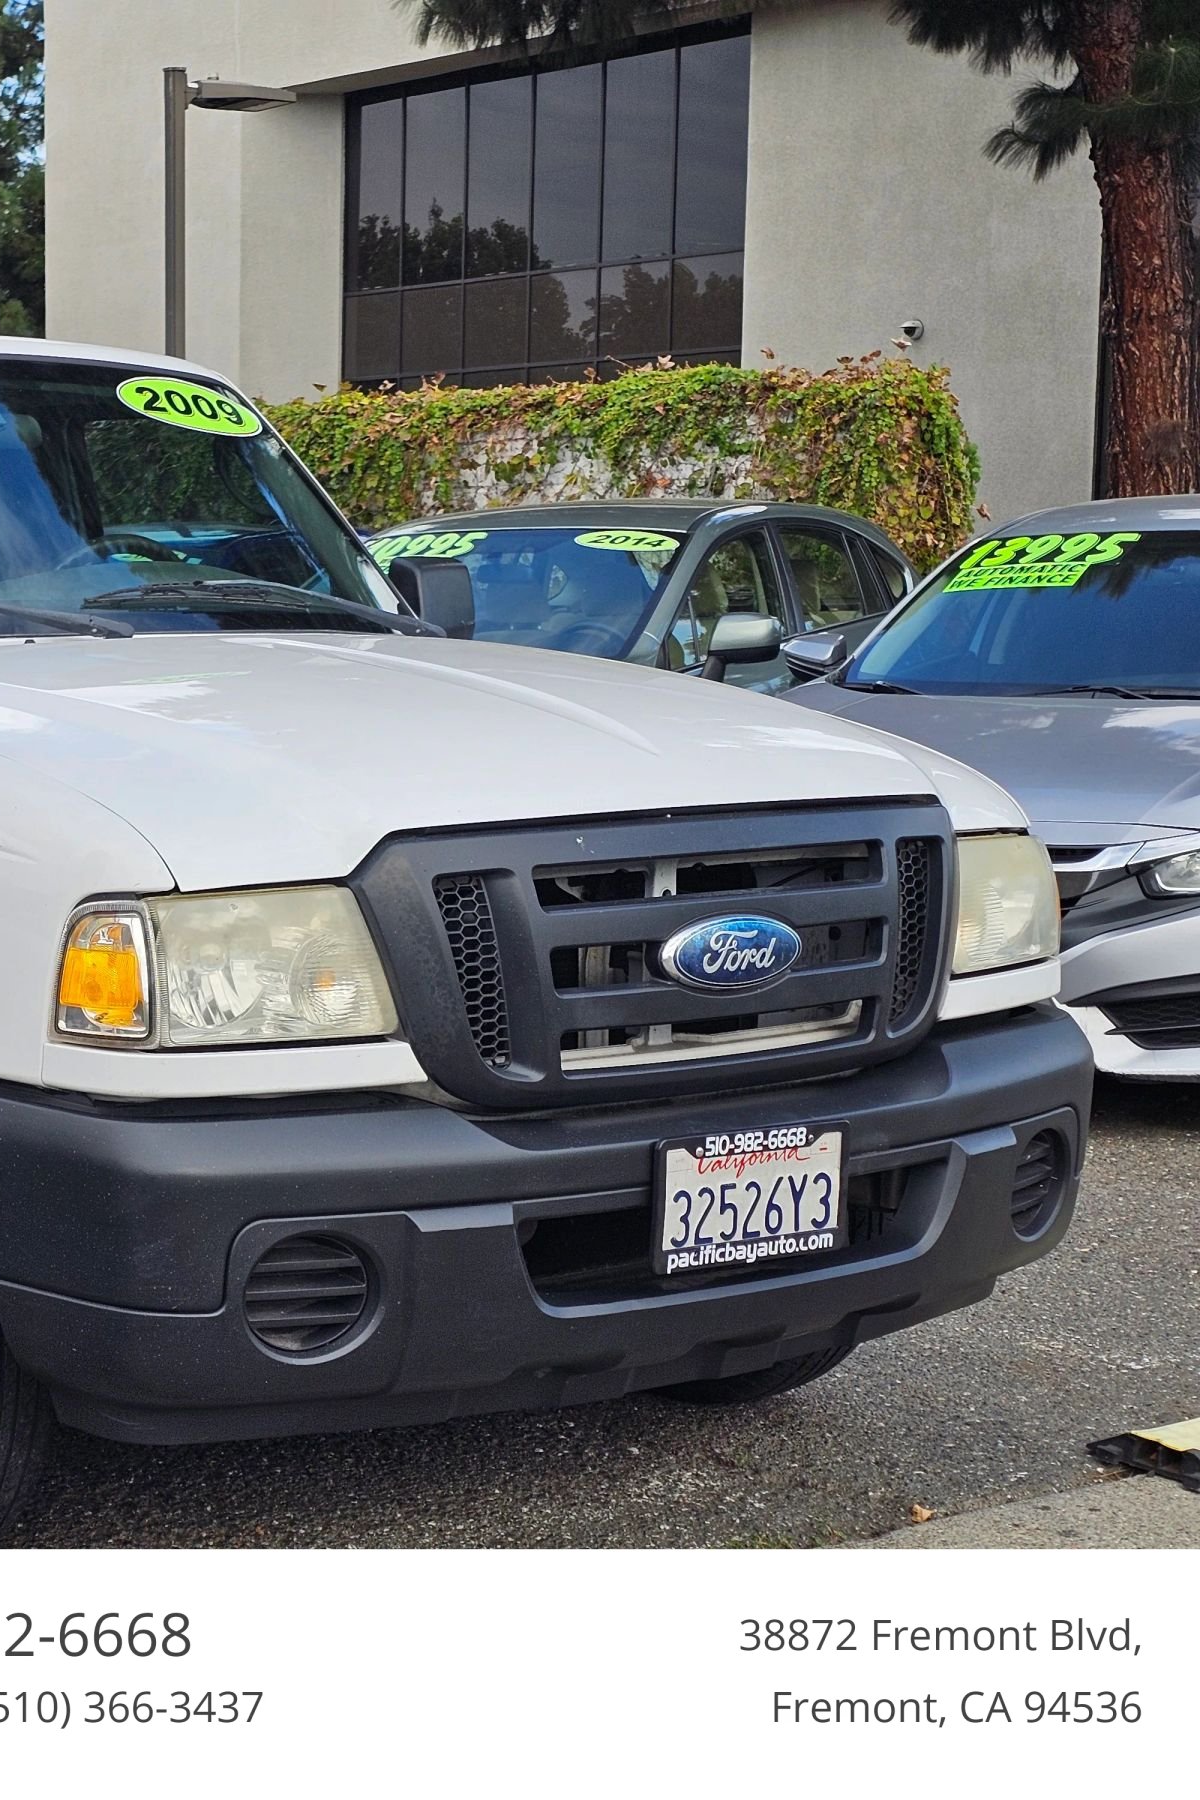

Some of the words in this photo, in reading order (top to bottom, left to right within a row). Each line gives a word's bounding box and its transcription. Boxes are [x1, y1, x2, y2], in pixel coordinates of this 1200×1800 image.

[134, 386, 244, 426] 2009
[586, 534, 668, 548] 2014
[959, 532, 1142, 569] 13995
[949, 577, 979, 589] WE
[983, 573, 1075, 587] FINANCE
[956, 563, 1085, 579] AUTOMATIC
[702, 928, 778, 975] Ford
[704, 1126, 808, 1157] 510-982-6668
[696, 1147, 811, 1178] California
[669, 1172, 832, 1248] 32526Y3
[666, 1232, 834, 1275] pacificbayauto.com
